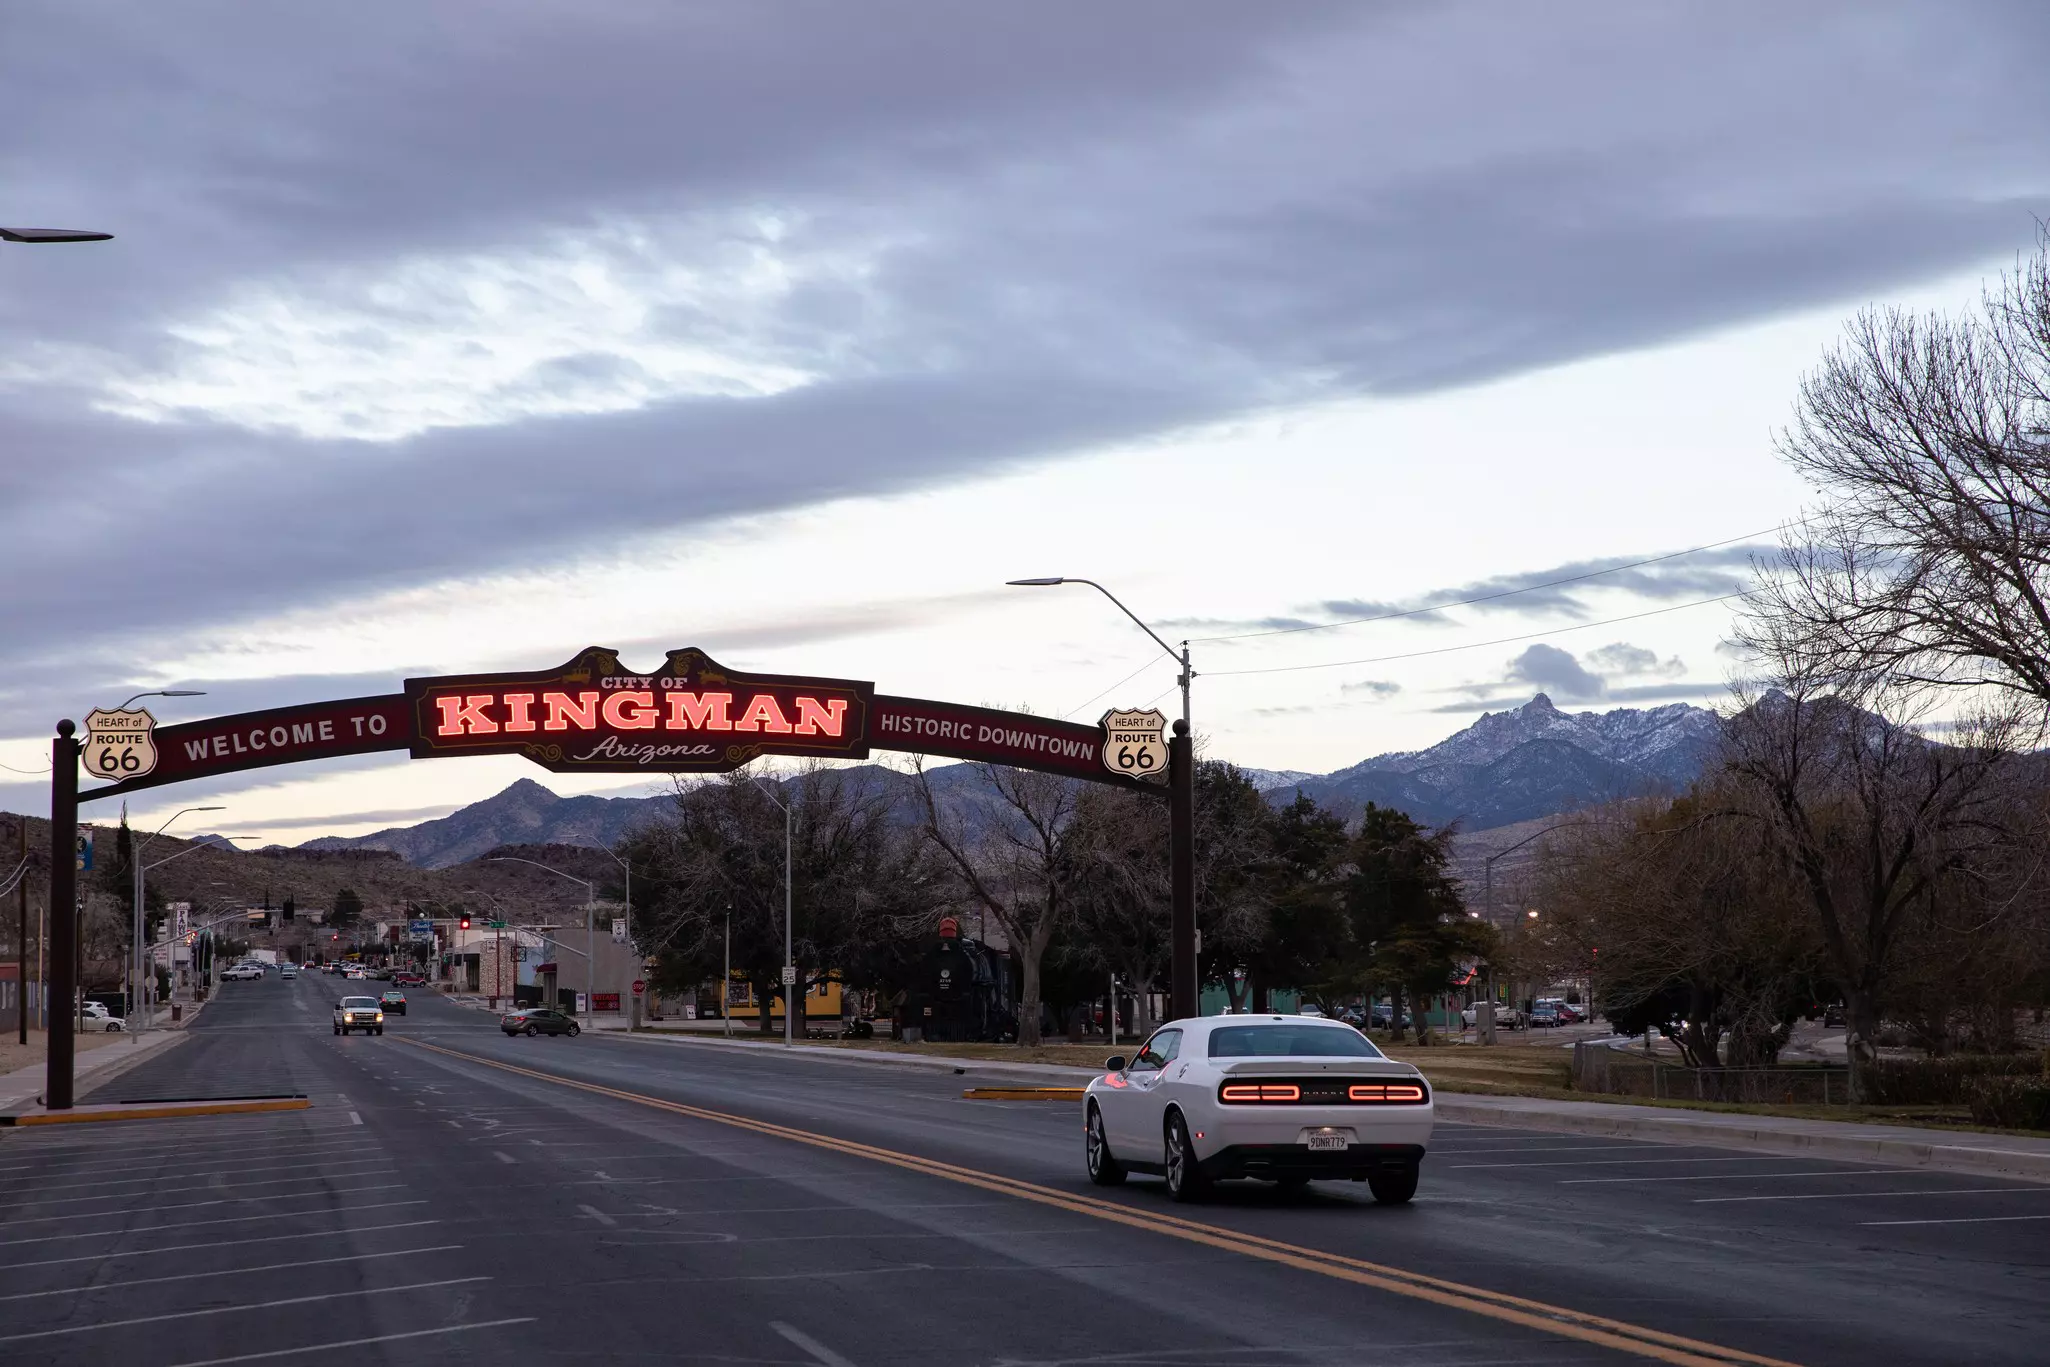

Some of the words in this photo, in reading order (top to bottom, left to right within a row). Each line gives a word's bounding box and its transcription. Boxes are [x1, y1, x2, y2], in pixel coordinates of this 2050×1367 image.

[601, 677, 654, 689] CITY
[660, 677, 688, 689] OF
[97, 718, 130, 727] HEART
[132, 718, 142, 727] of
[436, 690, 848, 737] KINGMAN
[1115, 718, 1144, 727] HEART
[1146, 718, 1155, 727] of
[96, 735, 143, 744] ROUTE
[184, 720, 335, 761] WELCOME
[351, 714, 387, 737] TO
[881, 714, 972, 740] HISTORIC
[978, 725, 1094, 761] DOWNTOWN
[1115, 734, 1156, 743] ROUTE
[573, 735, 716, 764] Arizona
[1118, 745, 1154, 769] 66
[99, 746, 140, 772] 66
[1310, 1137, 1345, 1148] 9DNR779
